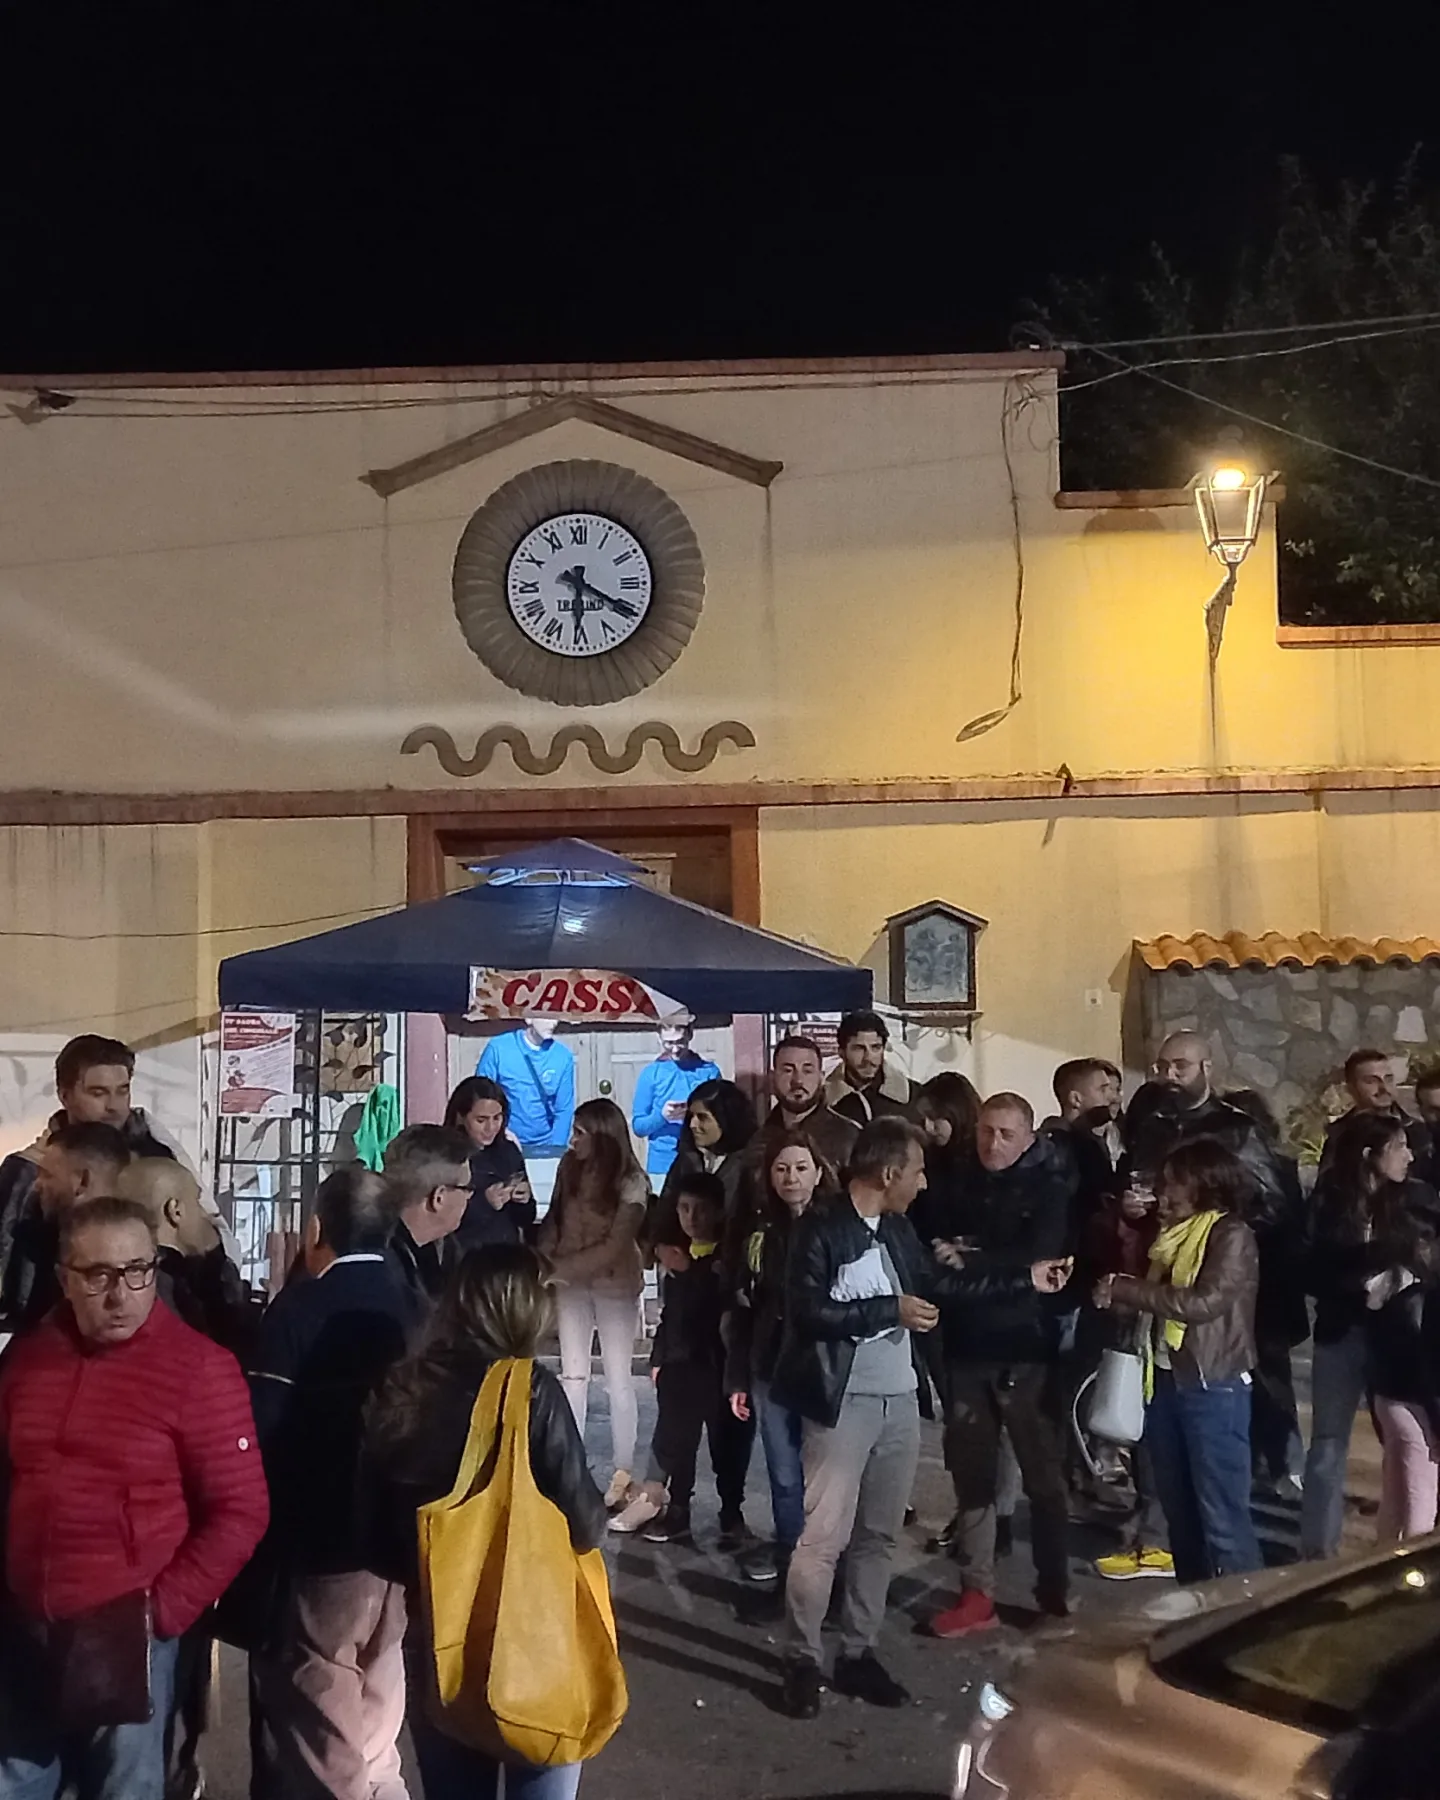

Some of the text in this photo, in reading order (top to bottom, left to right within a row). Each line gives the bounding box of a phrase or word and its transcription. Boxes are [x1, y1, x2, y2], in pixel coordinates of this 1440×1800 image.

[543, 531, 564, 553] XI
[569, 525, 588, 545] XII
[525, 552, 545, 569] X
